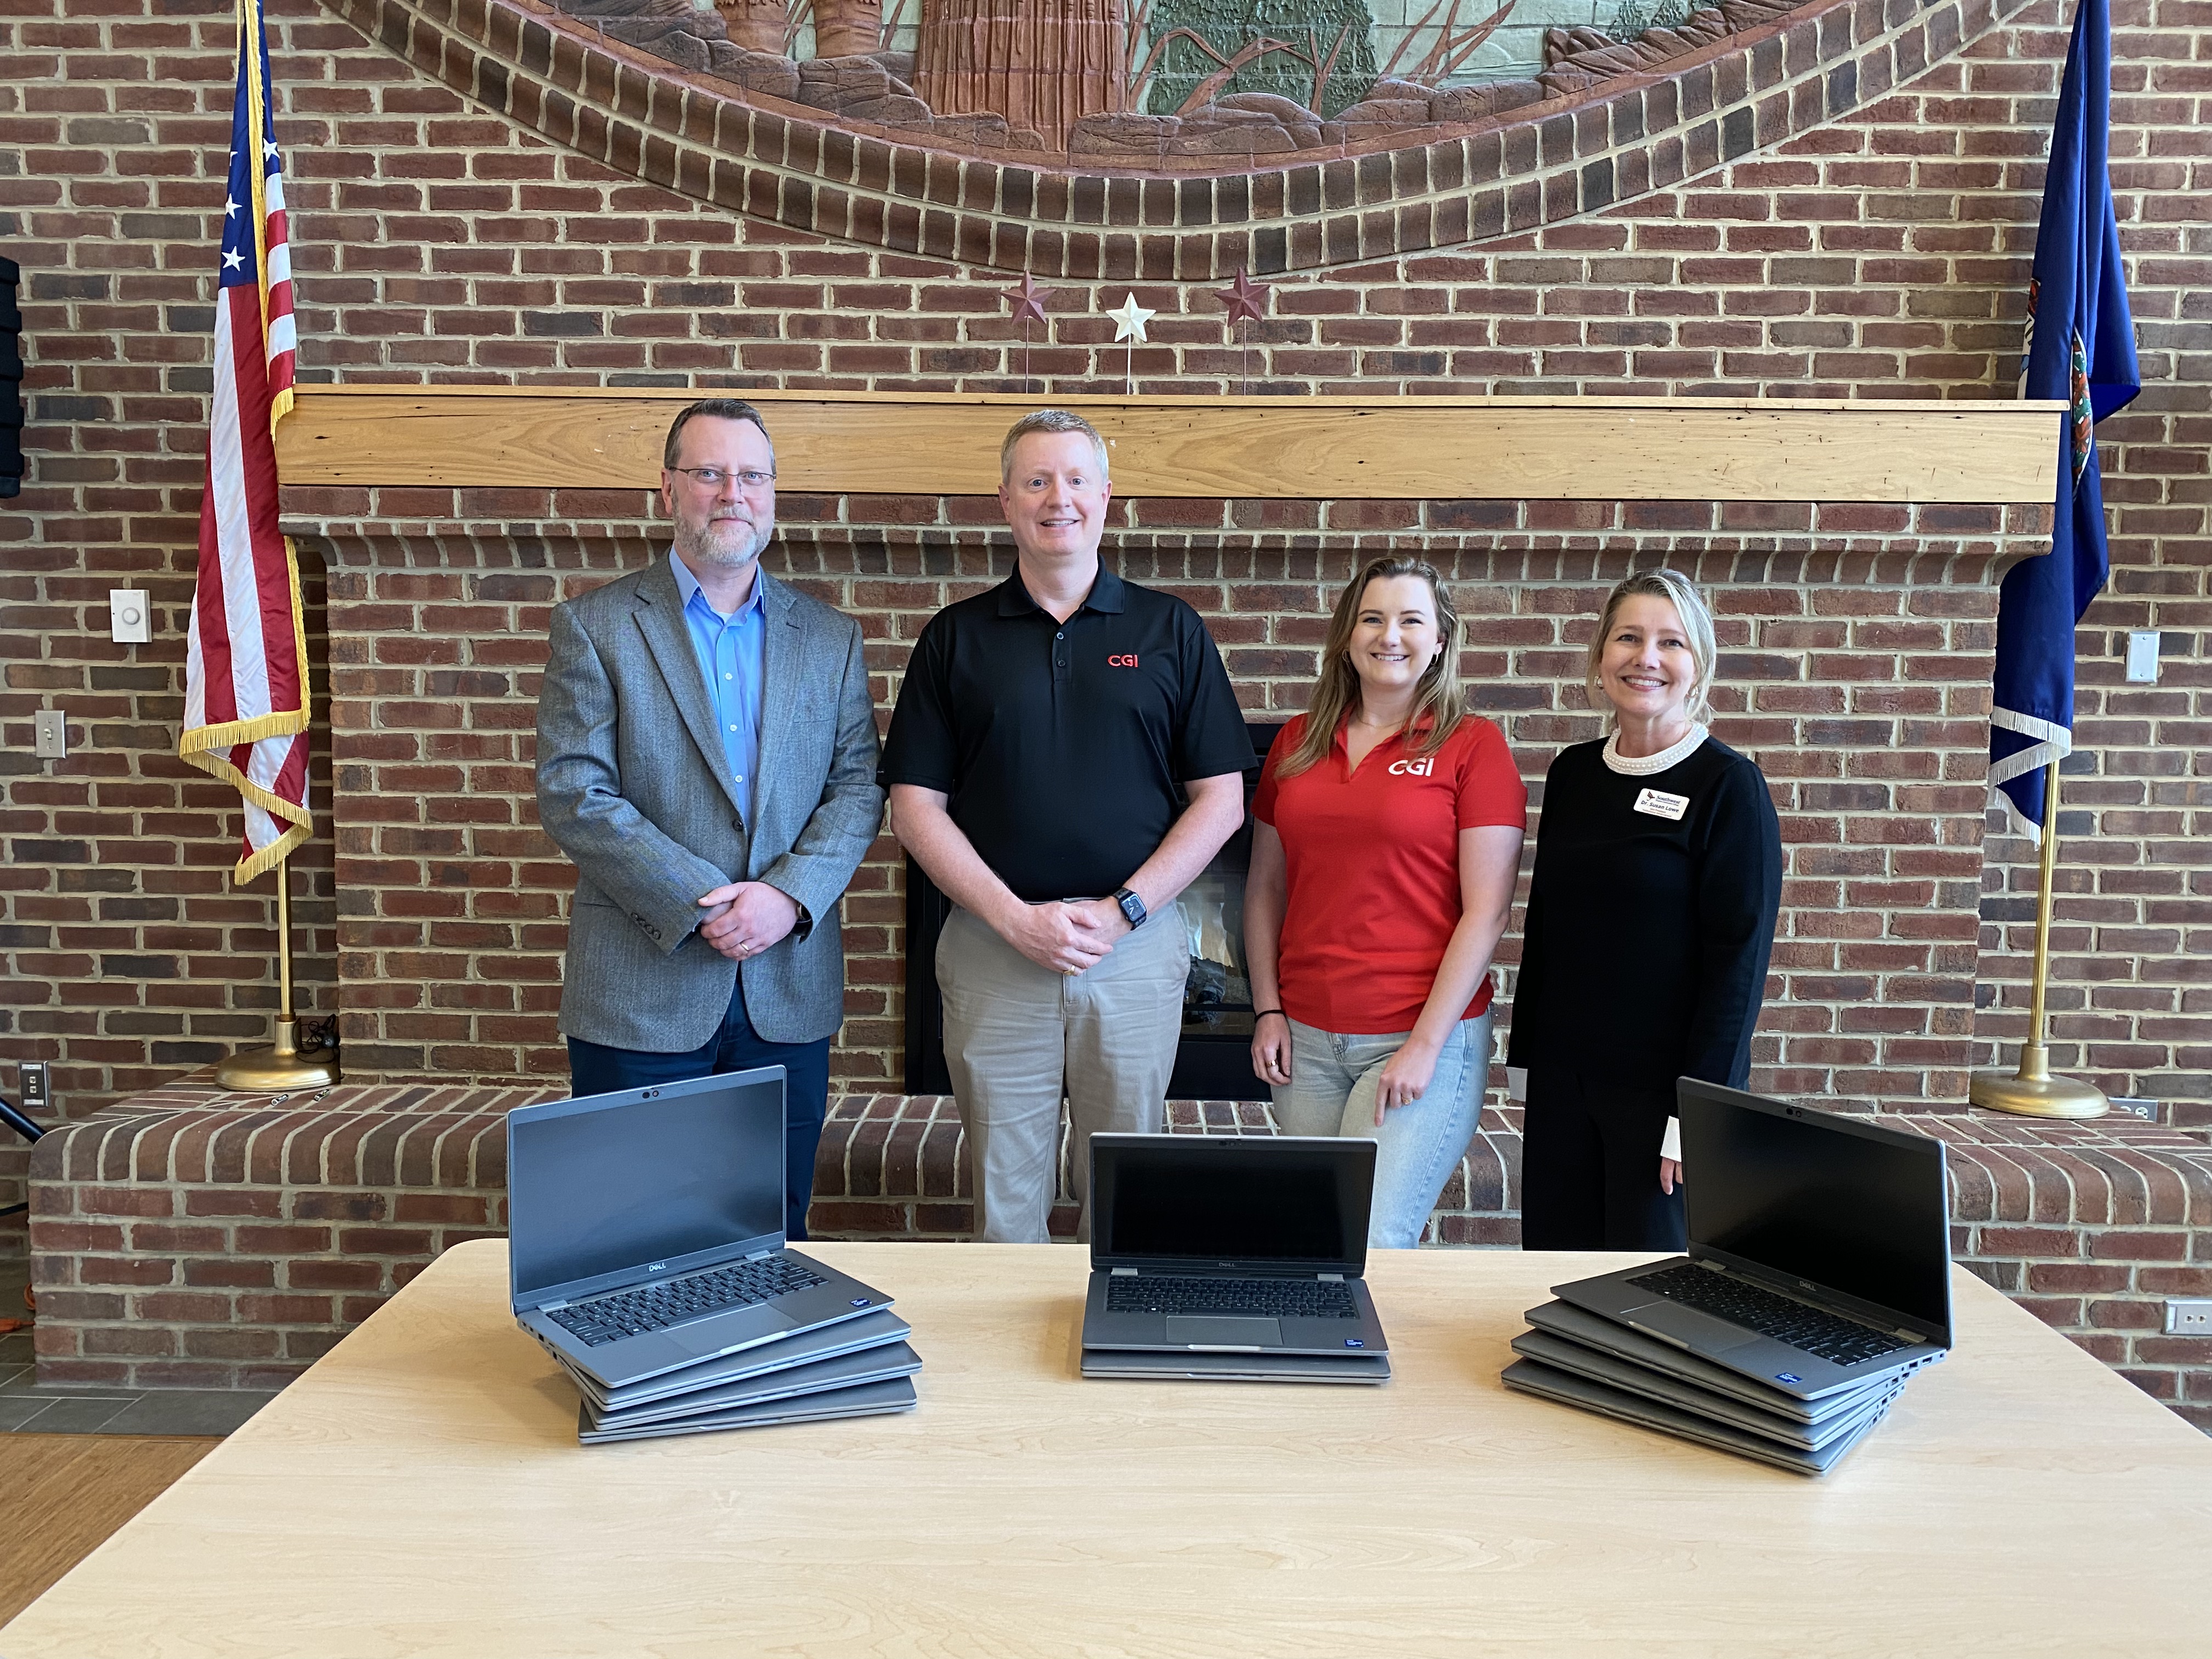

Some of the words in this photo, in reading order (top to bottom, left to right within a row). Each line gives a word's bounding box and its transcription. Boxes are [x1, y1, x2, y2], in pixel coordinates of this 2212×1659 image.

[1107, 654, 1138, 668] CGI
[1388, 758, 1434, 777] CGI
[648, 1262, 666, 1272] DELL
